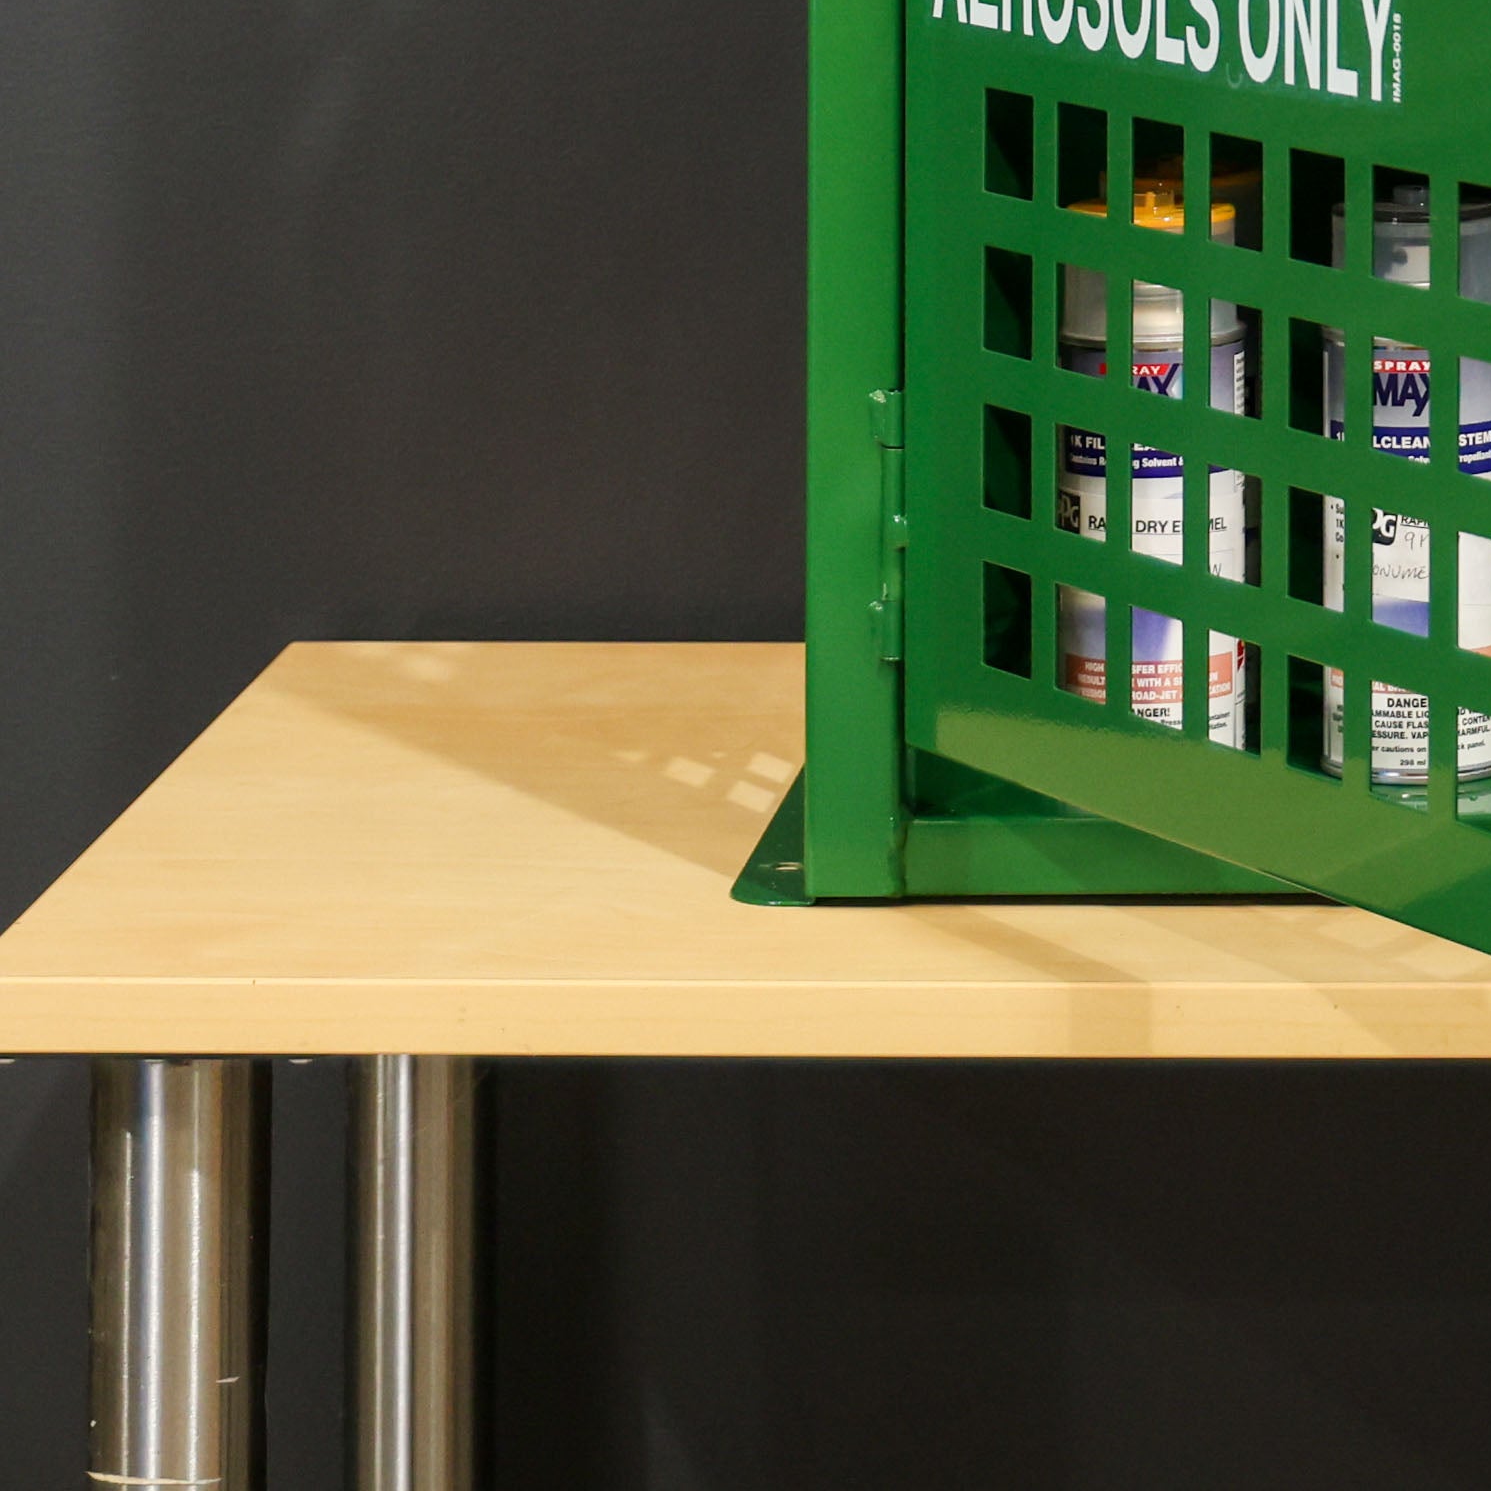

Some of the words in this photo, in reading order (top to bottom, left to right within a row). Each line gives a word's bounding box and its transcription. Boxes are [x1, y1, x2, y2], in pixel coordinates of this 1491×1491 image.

[1142, 458, 1177, 467] Solvent
[1136, 520, 1166, 533] DRY
[1374, 721, 1403, 729] CAUSE
